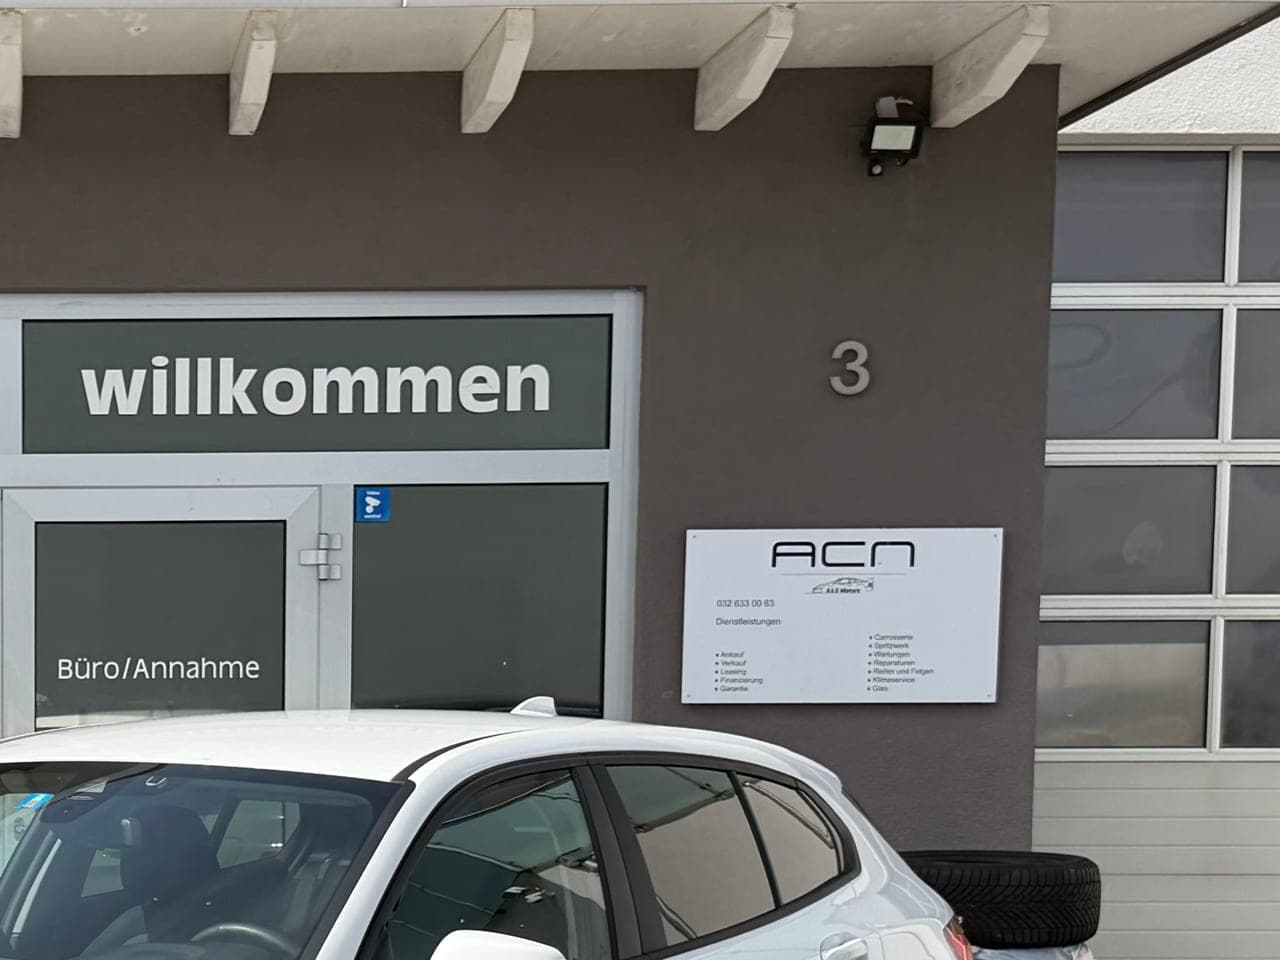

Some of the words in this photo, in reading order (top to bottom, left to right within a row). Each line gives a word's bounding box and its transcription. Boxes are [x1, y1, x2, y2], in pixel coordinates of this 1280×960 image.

[829, 340, 870, 395] 3
[81, 356, 550, 416] willkommen
[771, 541, 915, 567] ACN
[716, 599, 732, 607] 032
[751, 599, 763, 607] 00
[715, 617, 781, 627] Dienstleistungen
[57, 657, 260, 680] Büro/Annahme
